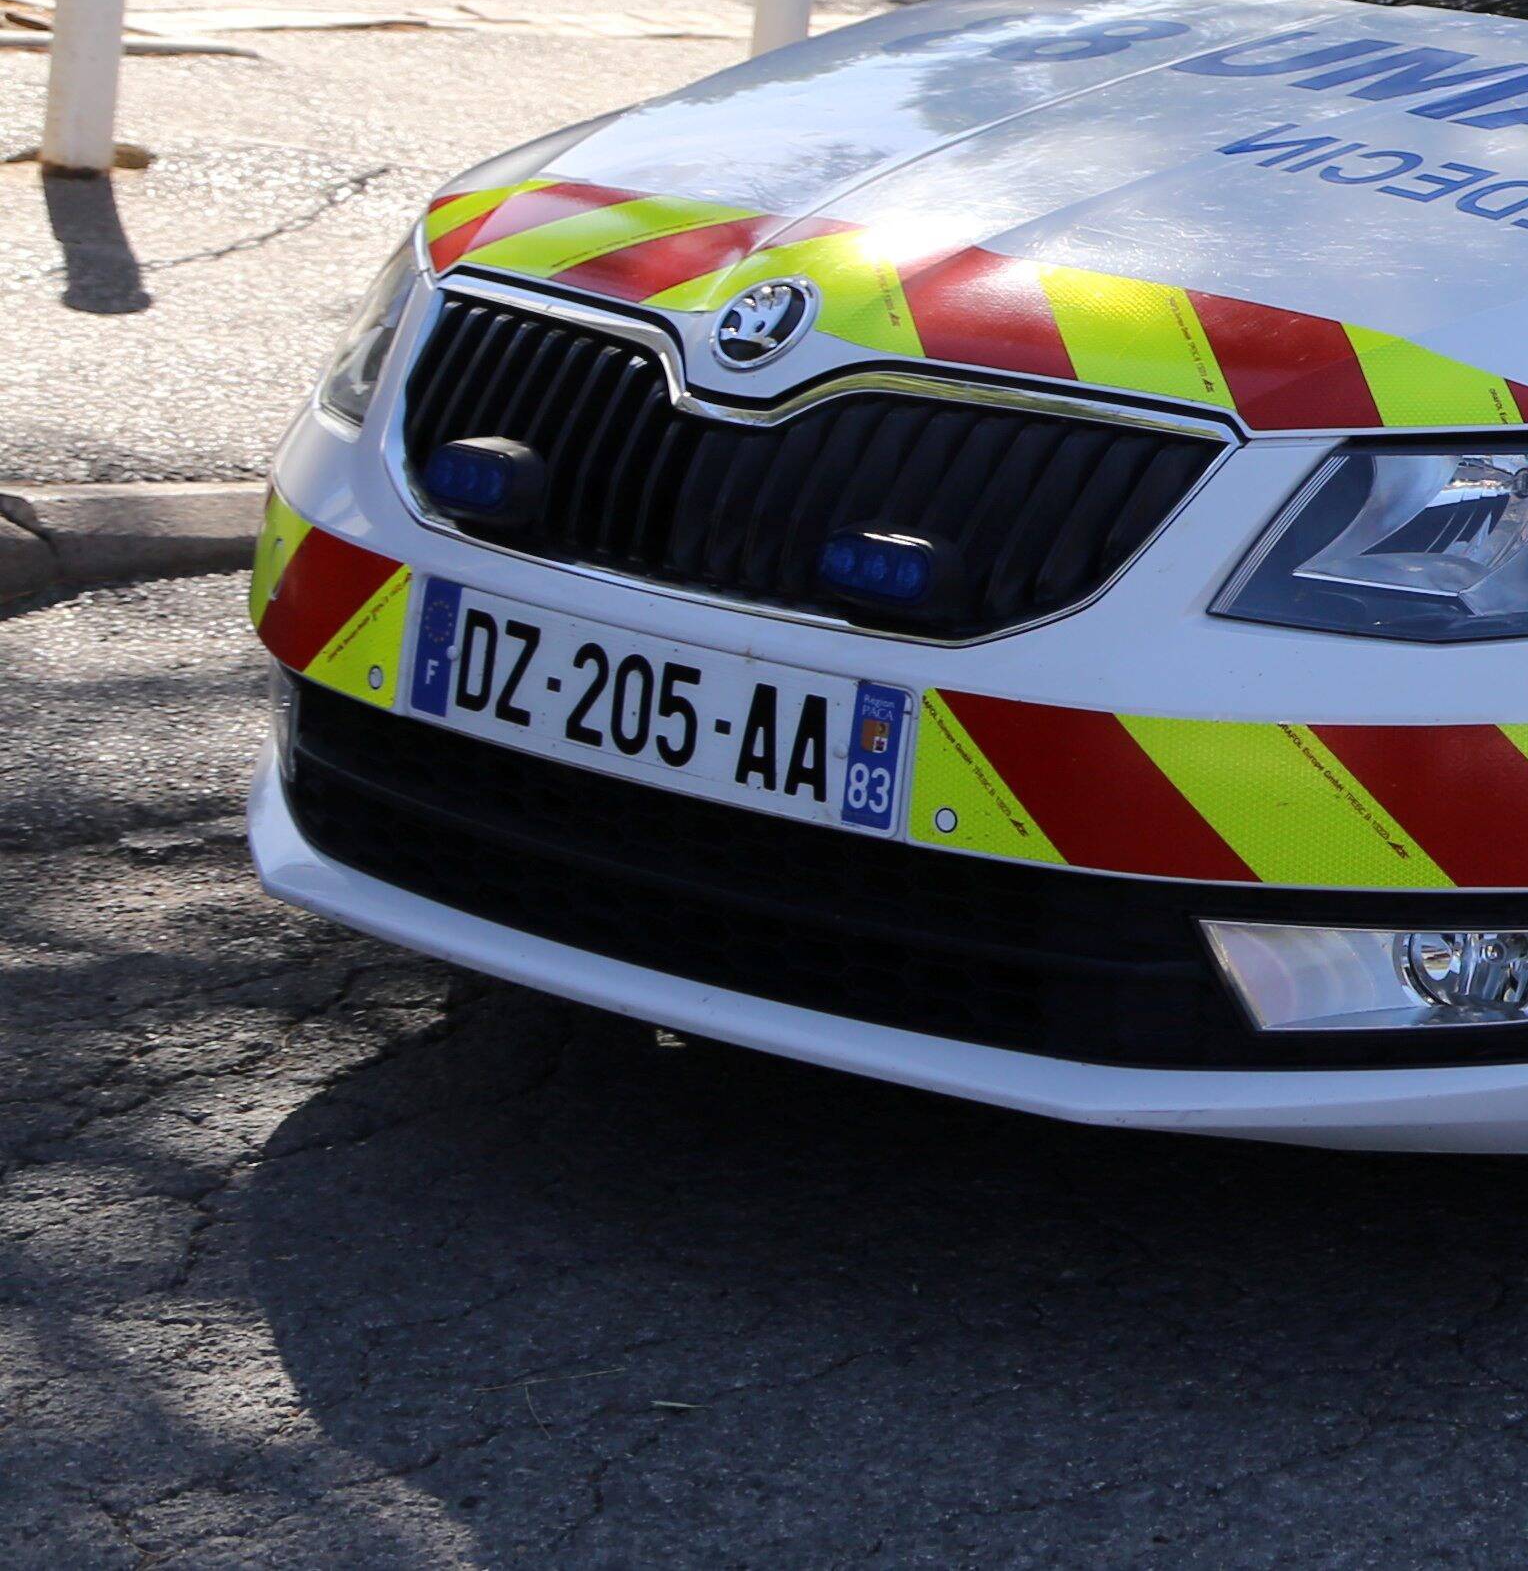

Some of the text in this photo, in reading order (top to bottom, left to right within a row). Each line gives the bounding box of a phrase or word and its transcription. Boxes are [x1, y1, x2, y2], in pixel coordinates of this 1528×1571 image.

[423, 659, 440, 685] F
[455, 607, 829, 803] DZ-205-AA
[862, 705, 894, 721] PACA
[848, 762, 891, 813] 83
